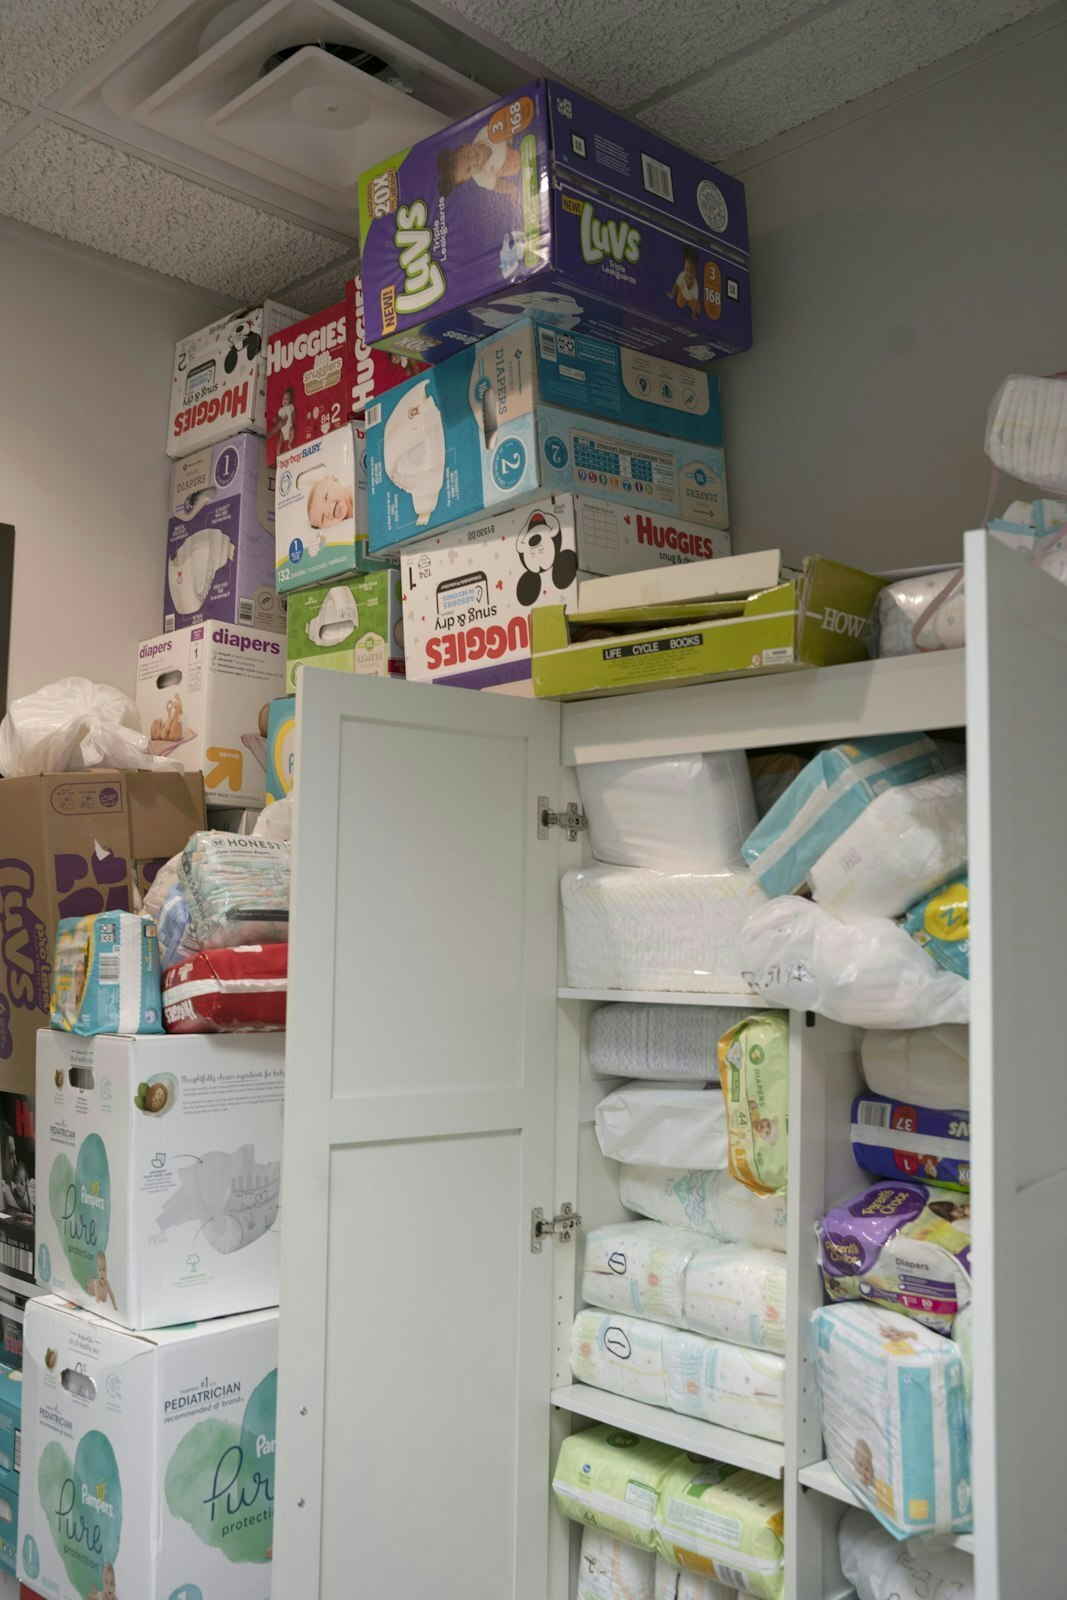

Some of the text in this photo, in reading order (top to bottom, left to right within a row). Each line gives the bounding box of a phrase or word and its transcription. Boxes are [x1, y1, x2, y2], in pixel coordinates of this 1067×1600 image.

[492, 120, 503, 134] 3
[510, 101, 521, 135] 168
[373, 174, 391, 219] 20X
[563, 199, 582, 215] NEW!
[433, 219, 442, 253] Triple
[439, 196, 448, 263] Leakguards
[602, 265, 638, 287] Leakguards
[608, 260, 627, 274] Triple
[709, 266, 717, 281] 3
[704, 287, 721, 306] 168
[384, 288, 396, 329] NEW!
[266, 317, 348, 377] HUGGIES
[177, 352, 187, 371] 2
[199, 383, 219, 400] snug
[495, 347, 508, 416] DIAPERS
[173, 381, 249, 437] HUGGIES
[182, 393, 195, 407] dry
[320, 413, 331, 425] 84
[330, 403, 342, 424] 2
[501, 451, 521, 476] 2
[550, 443, 562, 463] 2
[222, 454, 231, 477] 1
[176, 473, 207, 494] DIAPERS
[685, 487, 718, 503] DIAPERS
[292, 539, 300, 552] 1
[636, 514, 713, 560] HUGGIES
[659, 551, 677, 565] snug
[277, 569, 291, 583] 132
[408, 566, 418, 591] 1
[419, 568, 432, 579] 124
[443, 594, 476, 610] ABSORBS
[434, 605, 498, 631] snug & dry
[820, 606, 868, 638] HOW
[139, 640, 173, 660] diapers
[212, 628, 281, 656] diapers
[425, 614, 532, 671] UGGIES
[605, 635, 700, 660] LIFE CYCLE BOOKS
[227, 838, 282, 851] HONEST
[753, 1068, 767, 1111] DIAPERS
[738, 1111, 748, 1127] 44
[895, 1117, 914, 1131] 37
[902, 1158, 911, 1171] 1
[80, 1184, 105, 1211] Pampers
[61, 1183, 99, 1246] Pure
[67, 1243, 95, 1262] protection
[824, 1239, 859, 1256] Parent's
[895, 1256, 930, 1271] Diapers
[200, 1376, 209, 1389] #1
[164, 1381, 242, 1413] PEDIATRICIAN
[39, 1407, 73, 1431] PEDIATRICIAN
[164, 1404, 212, 1424] recommended
[203, 1445, 275, 1521] Pur
[81, 1483, 115, 1518] Pampers
[54, 1478, 103, 1555] Pure
[221, 1509, 274, 1538] protecti
[582, 1511, 598, 1525] 44
[63, 1543, 101, 1571] protection
